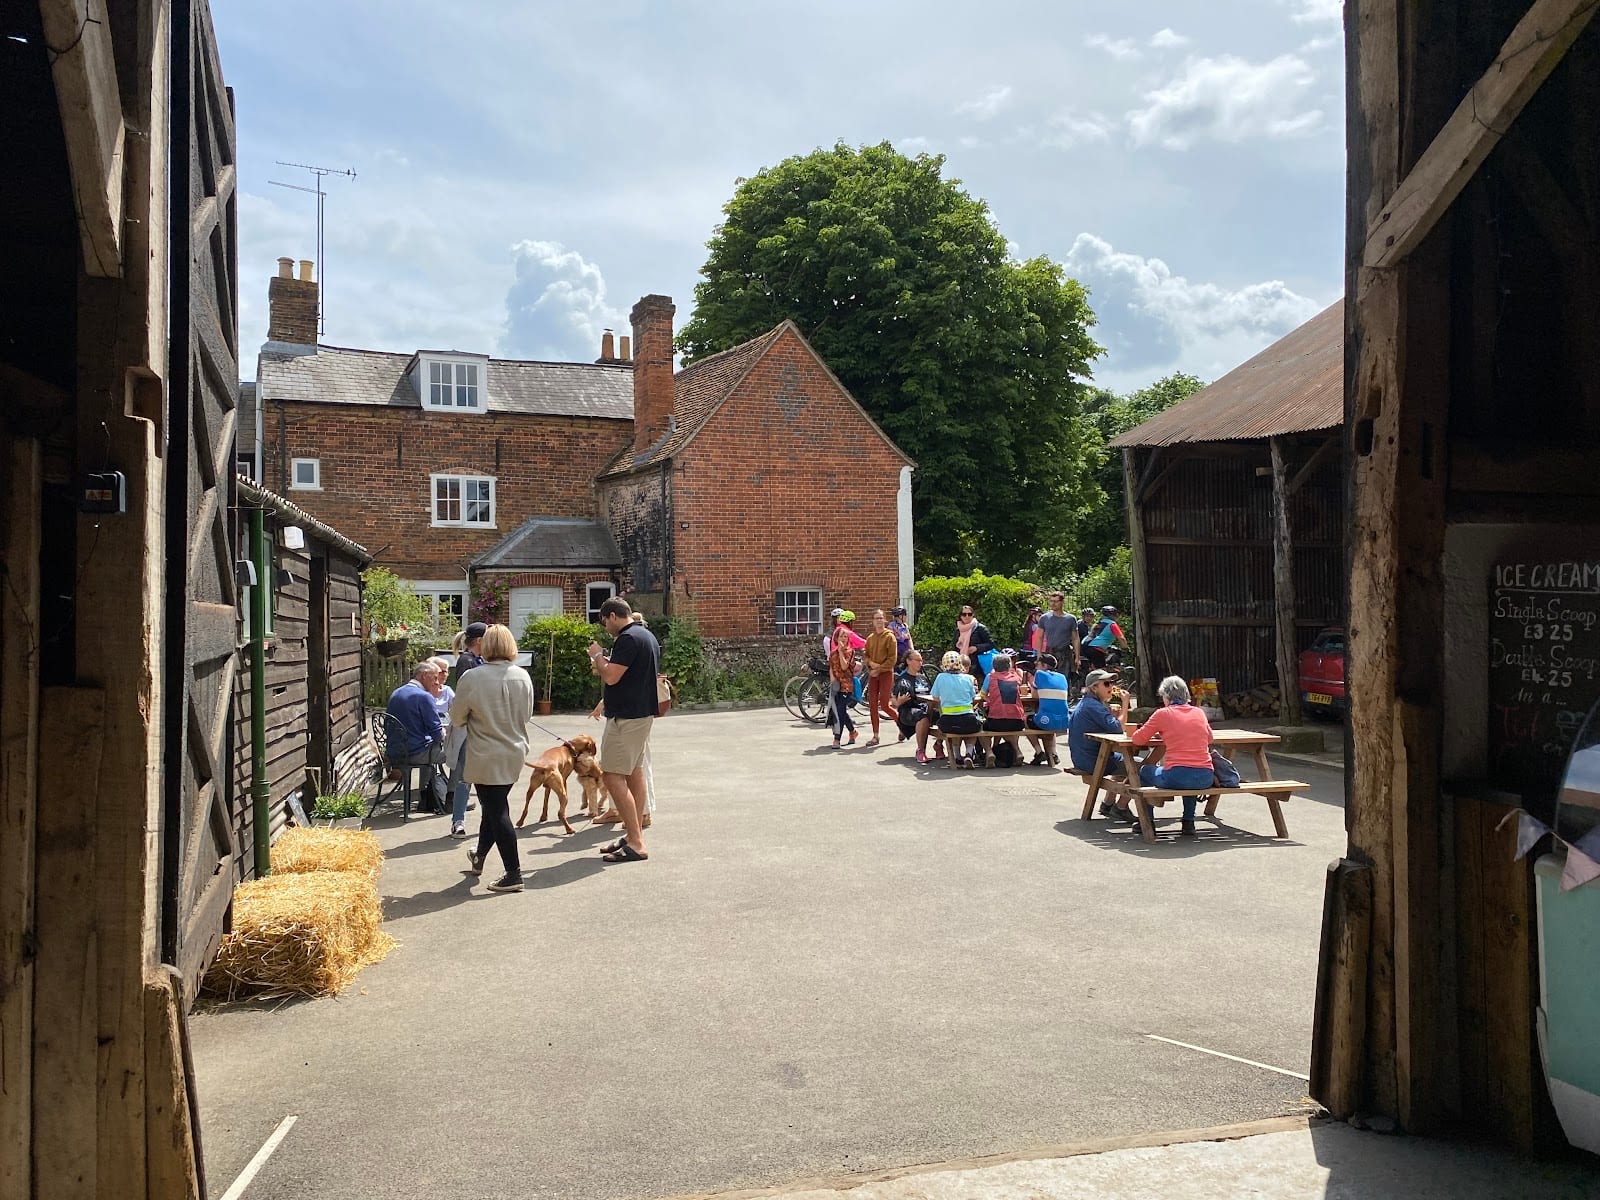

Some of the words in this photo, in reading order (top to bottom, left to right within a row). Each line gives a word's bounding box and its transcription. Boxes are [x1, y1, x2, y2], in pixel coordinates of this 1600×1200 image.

[1495, 564, 1526, 587] ICE
[1530, 562, 1600, 588] CREAM
[1494, 596, 1545, 625] Single
[1546, 598, 1597, 631] Scoop
